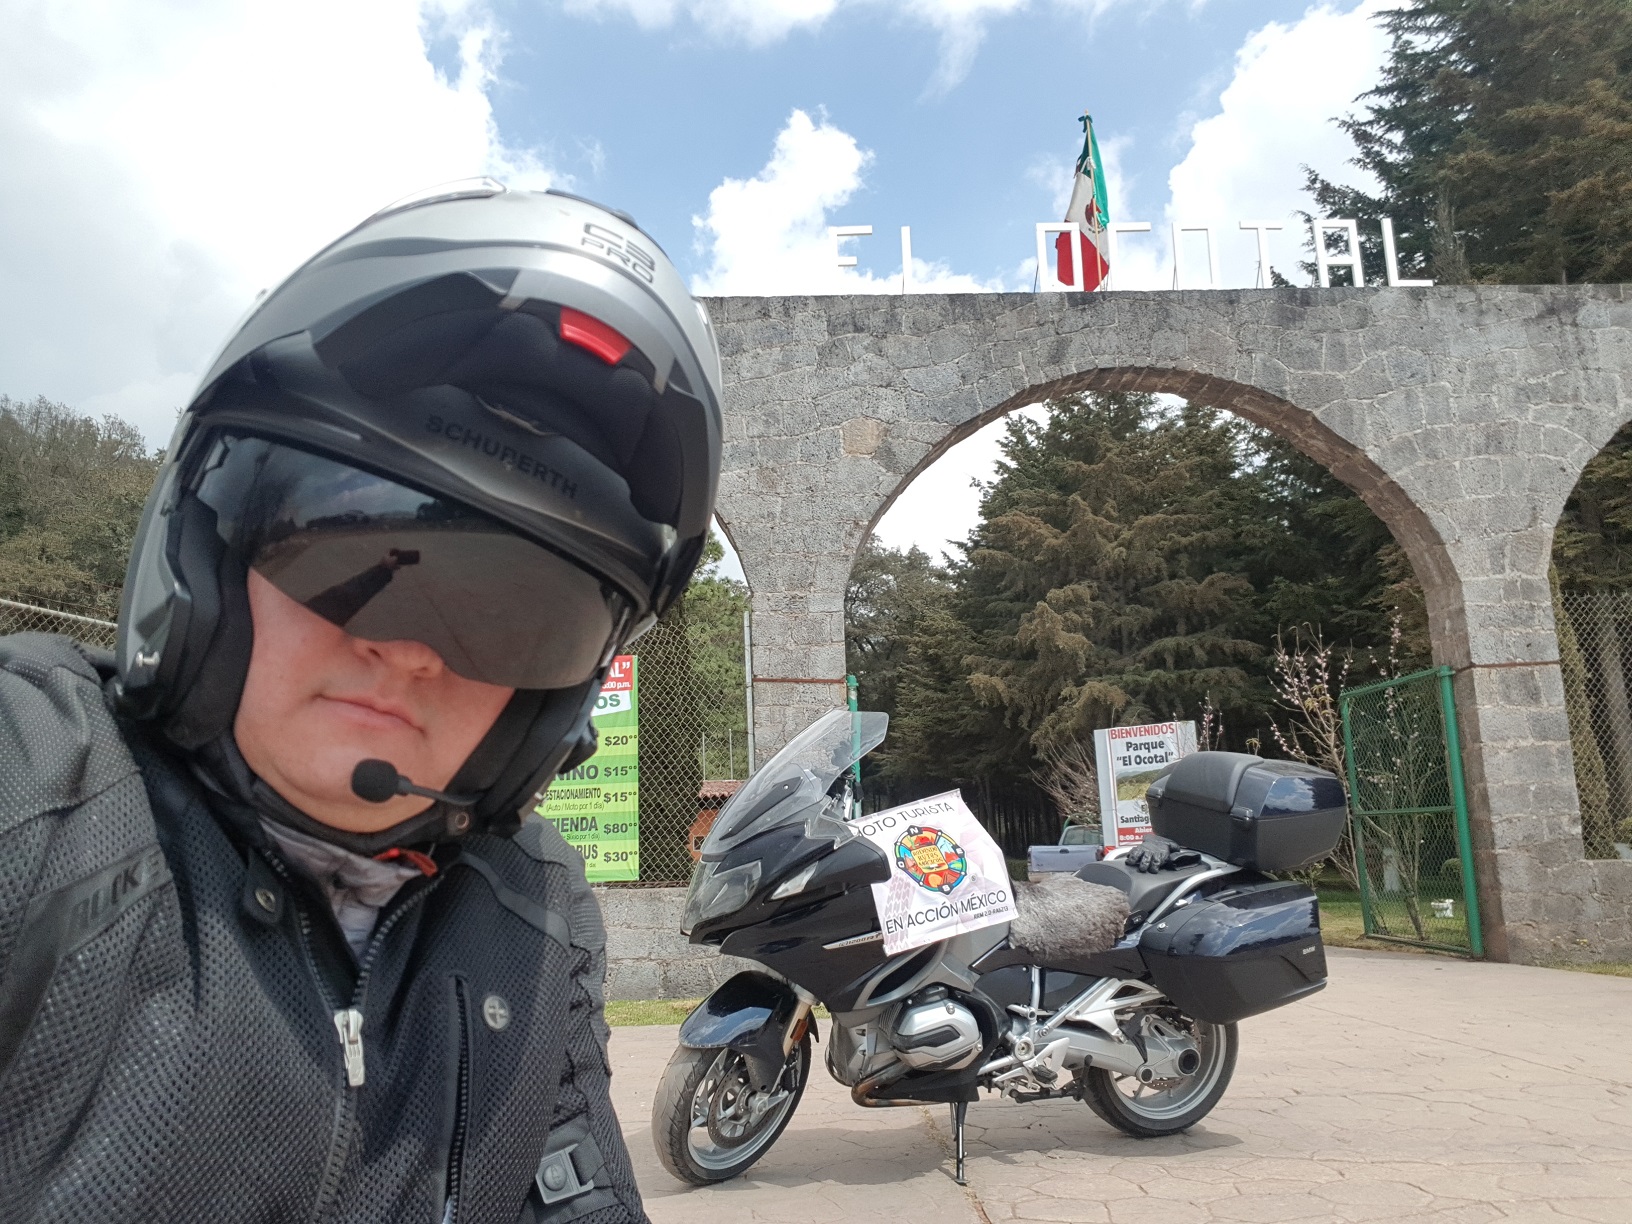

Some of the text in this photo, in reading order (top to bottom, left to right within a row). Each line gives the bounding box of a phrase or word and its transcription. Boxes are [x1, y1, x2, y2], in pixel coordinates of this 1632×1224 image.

[581, 237, 654, 284] PRO
[1109, 723, 1175, 740] BIENVENIDOS
[1126, 740, 1165, 753] Parque
[546, 787, 602, 801] ESTACIONAMIENTO
[861, 802, 955, 836] OTO TURISTA
[886, 889, 1008, 935] EN ACCIÓN MÉXICO
